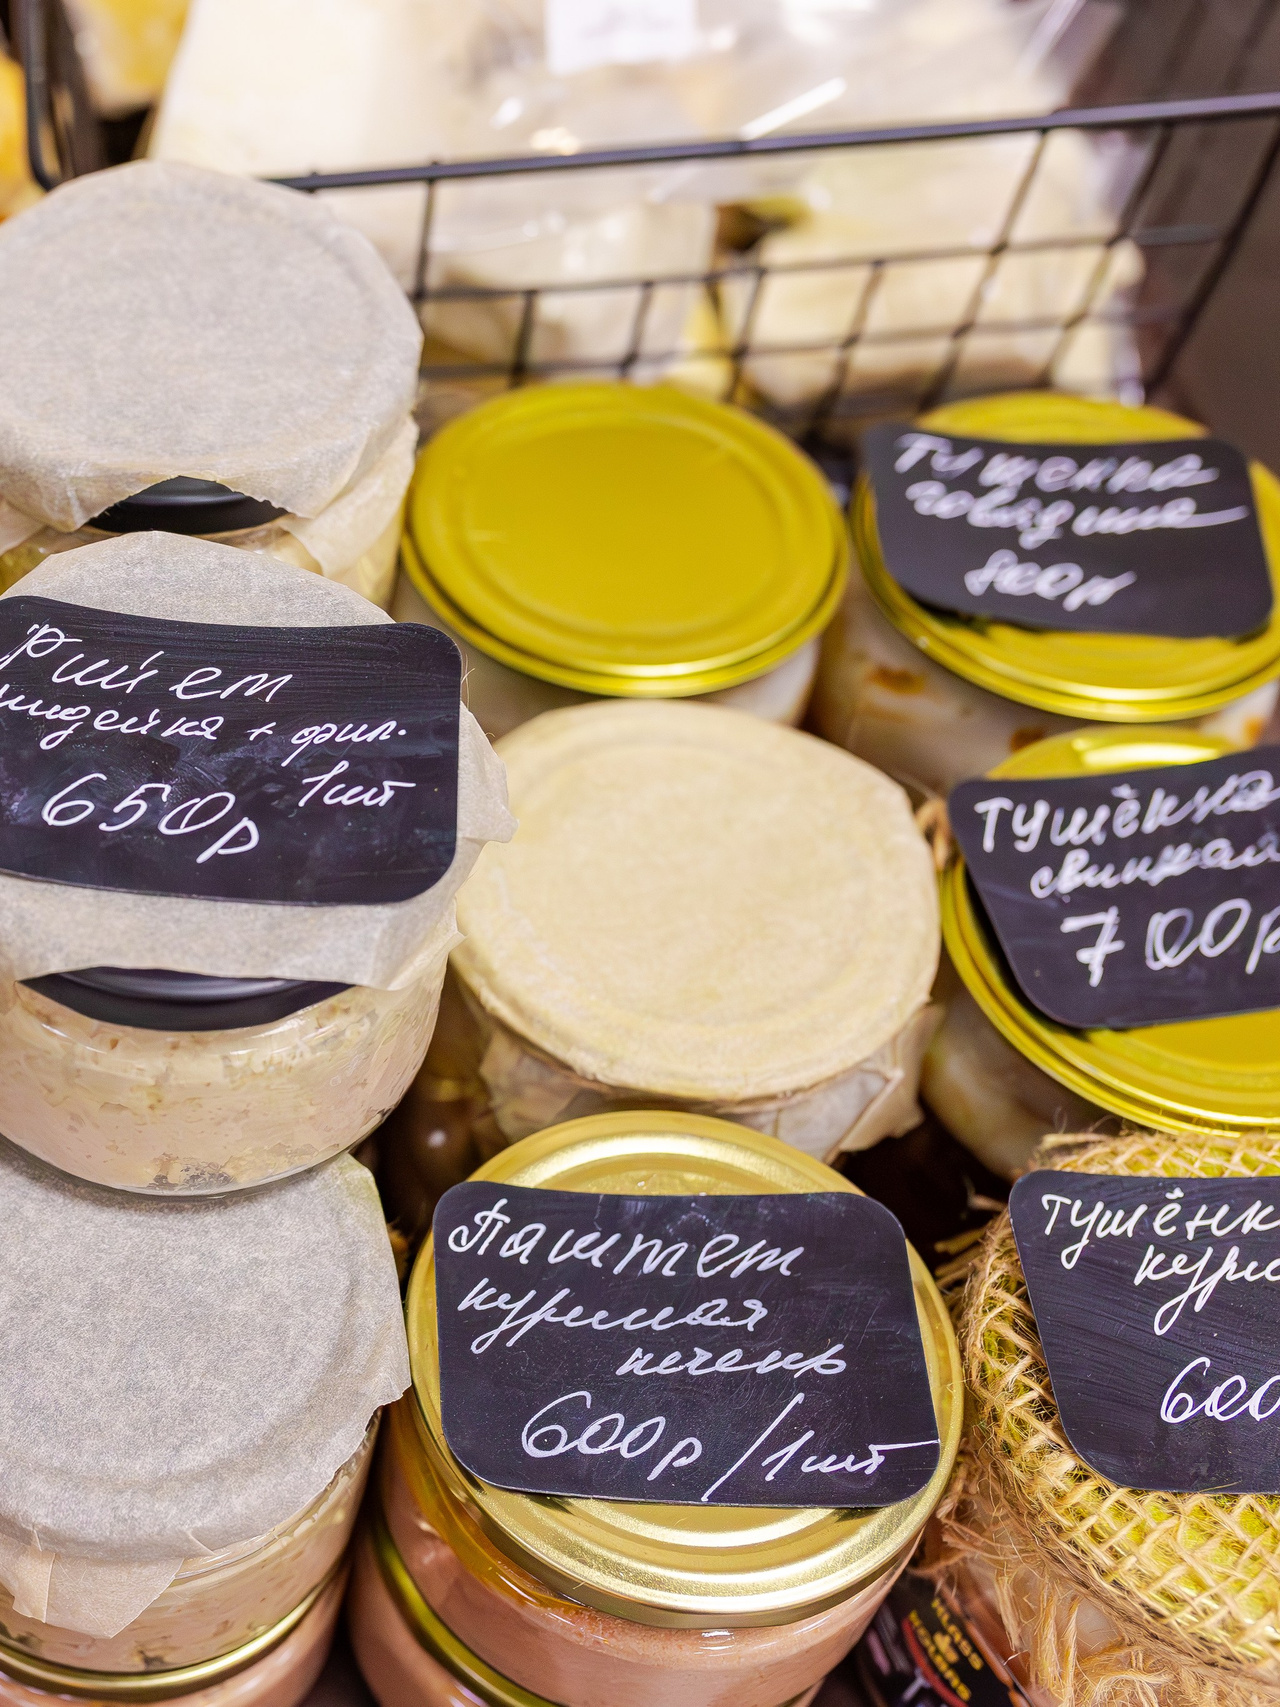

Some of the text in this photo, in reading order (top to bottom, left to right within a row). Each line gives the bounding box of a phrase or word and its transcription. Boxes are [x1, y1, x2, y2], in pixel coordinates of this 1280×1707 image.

[245, 721, 274, 742] +
[40, 771, 260, 864] 650р
[447, 1196, 806, 1280] Паштет
[456, 1276, 769, 1356] куриная
